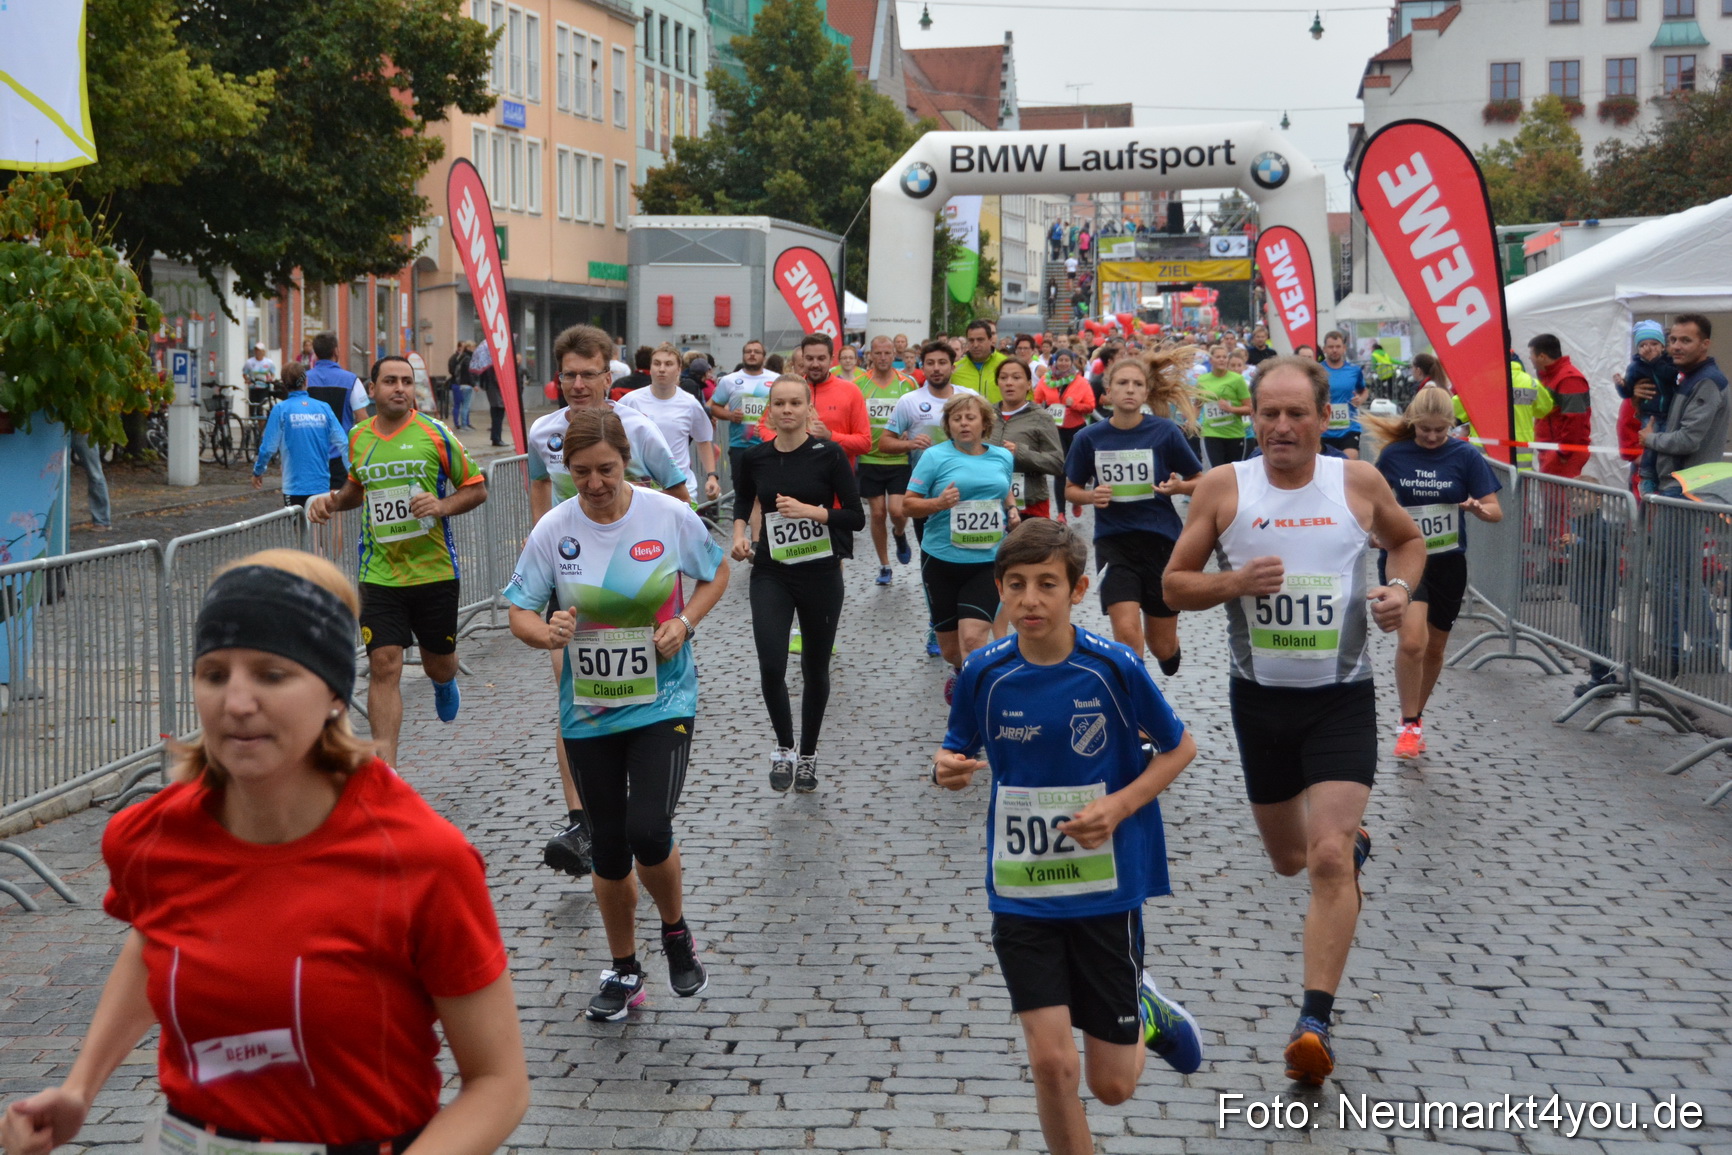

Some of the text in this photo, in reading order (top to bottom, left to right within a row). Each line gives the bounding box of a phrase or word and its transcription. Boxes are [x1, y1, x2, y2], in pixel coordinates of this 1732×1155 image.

[950, 139, 1236, 175] BMW Laufsport
[1158, 265, 1192, 277] ZIEL
[175, 356, 186, 371] P
[745, 403, 763, 414] 508
[355, 460, 427, 483] BOCK
[1101, 462, 1149, 482] 5319
[1415, 469, 1436, 478] Titel
[1399, 478, 1453, 490] Verteidiger
[1412, 488, 1440, 497] Innen
[956, 511, 999, 531] 5224
[1274, 516, 1338, 528] KLEBL
[390, 525, 407, 534] Alaa
[773, 520, 823, 545] 5268
[962, 534, 994, 542] Elisabeth
[785, 545, 818, 558] Melanie
[1287, 575, 1333, 586] BOCK
[1255, 594, 1333, 626] 5015
[604, 630, 647, 641] BOCK
[1272, 634, 1316, 647] Roland
[578, 646, 648, 677] 5075
[593, 683, 634, 696] Claudia
[1073, 697, 1101, 709] Yannik
[1075, 718, 1090, 735] FSV
[1038, 790, 1095, 805] BOCK
[1006, 815, 1075, 856] 502
[1025, 864, 1081, 882] Yannik
